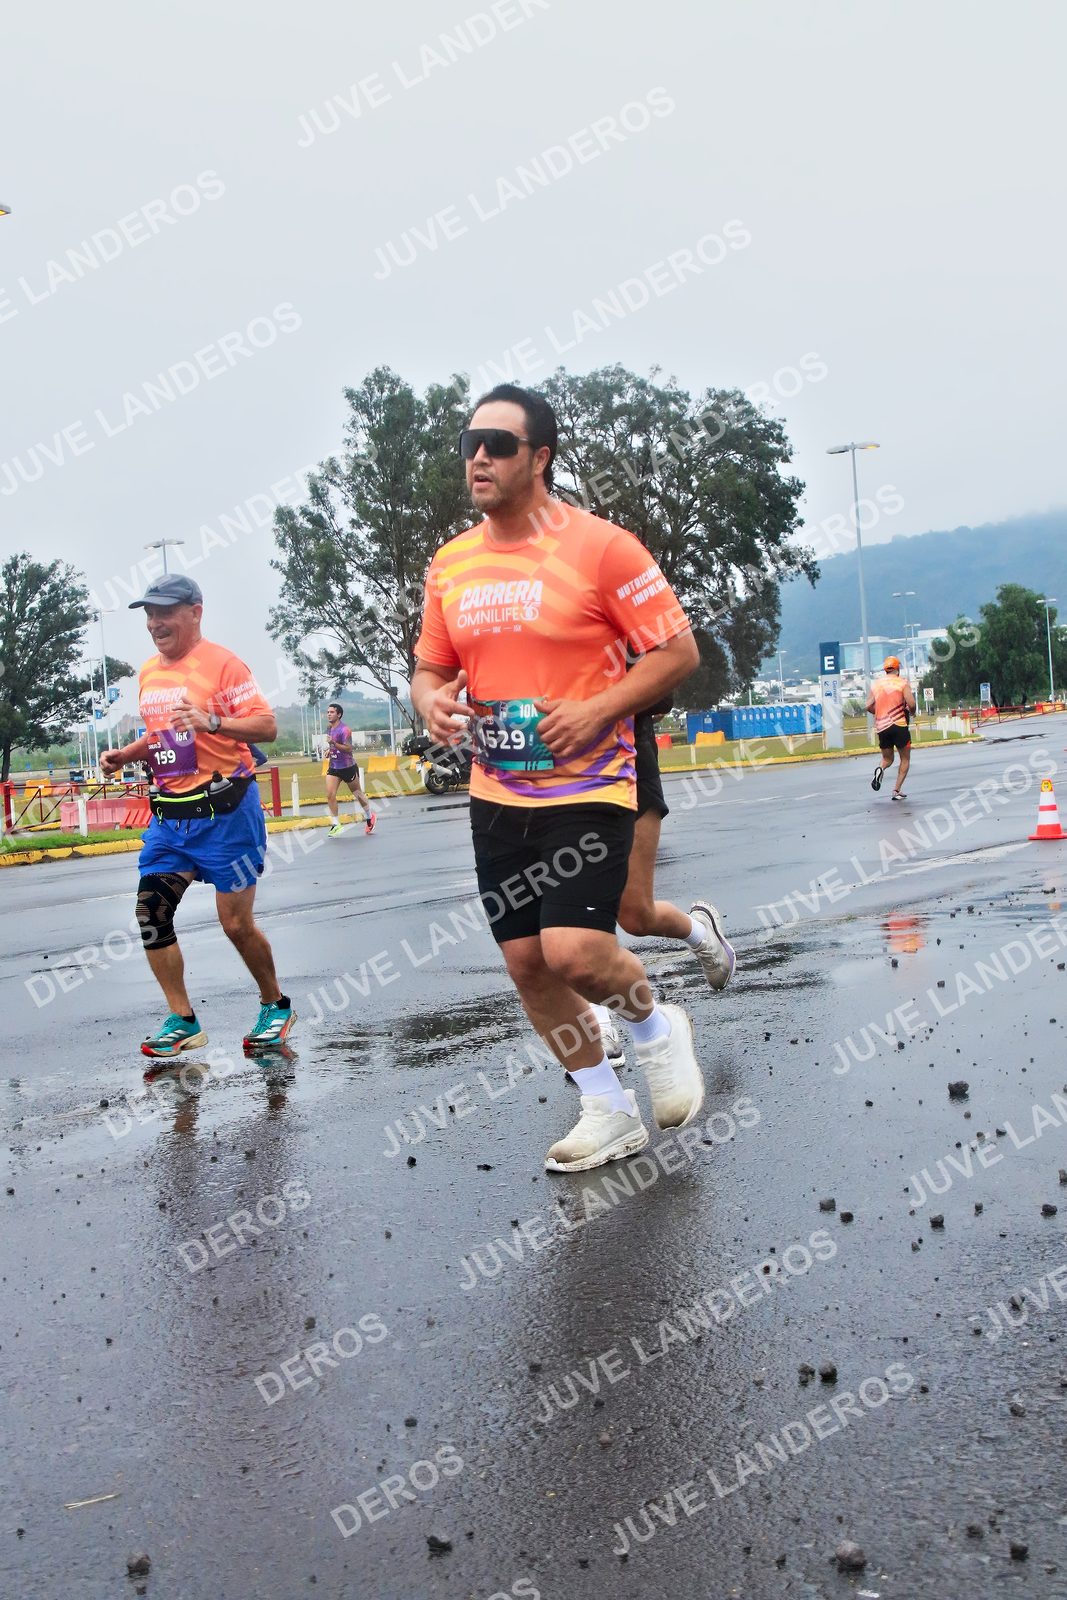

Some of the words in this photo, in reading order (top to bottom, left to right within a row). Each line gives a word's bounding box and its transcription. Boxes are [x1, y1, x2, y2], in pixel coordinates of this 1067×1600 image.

[459, 580, 543, 612] CARRERA
[457, 606, 520, 629] OMNILIFE
[824, 655, 835, 671] E
[154, 749, 177, 765] 159
